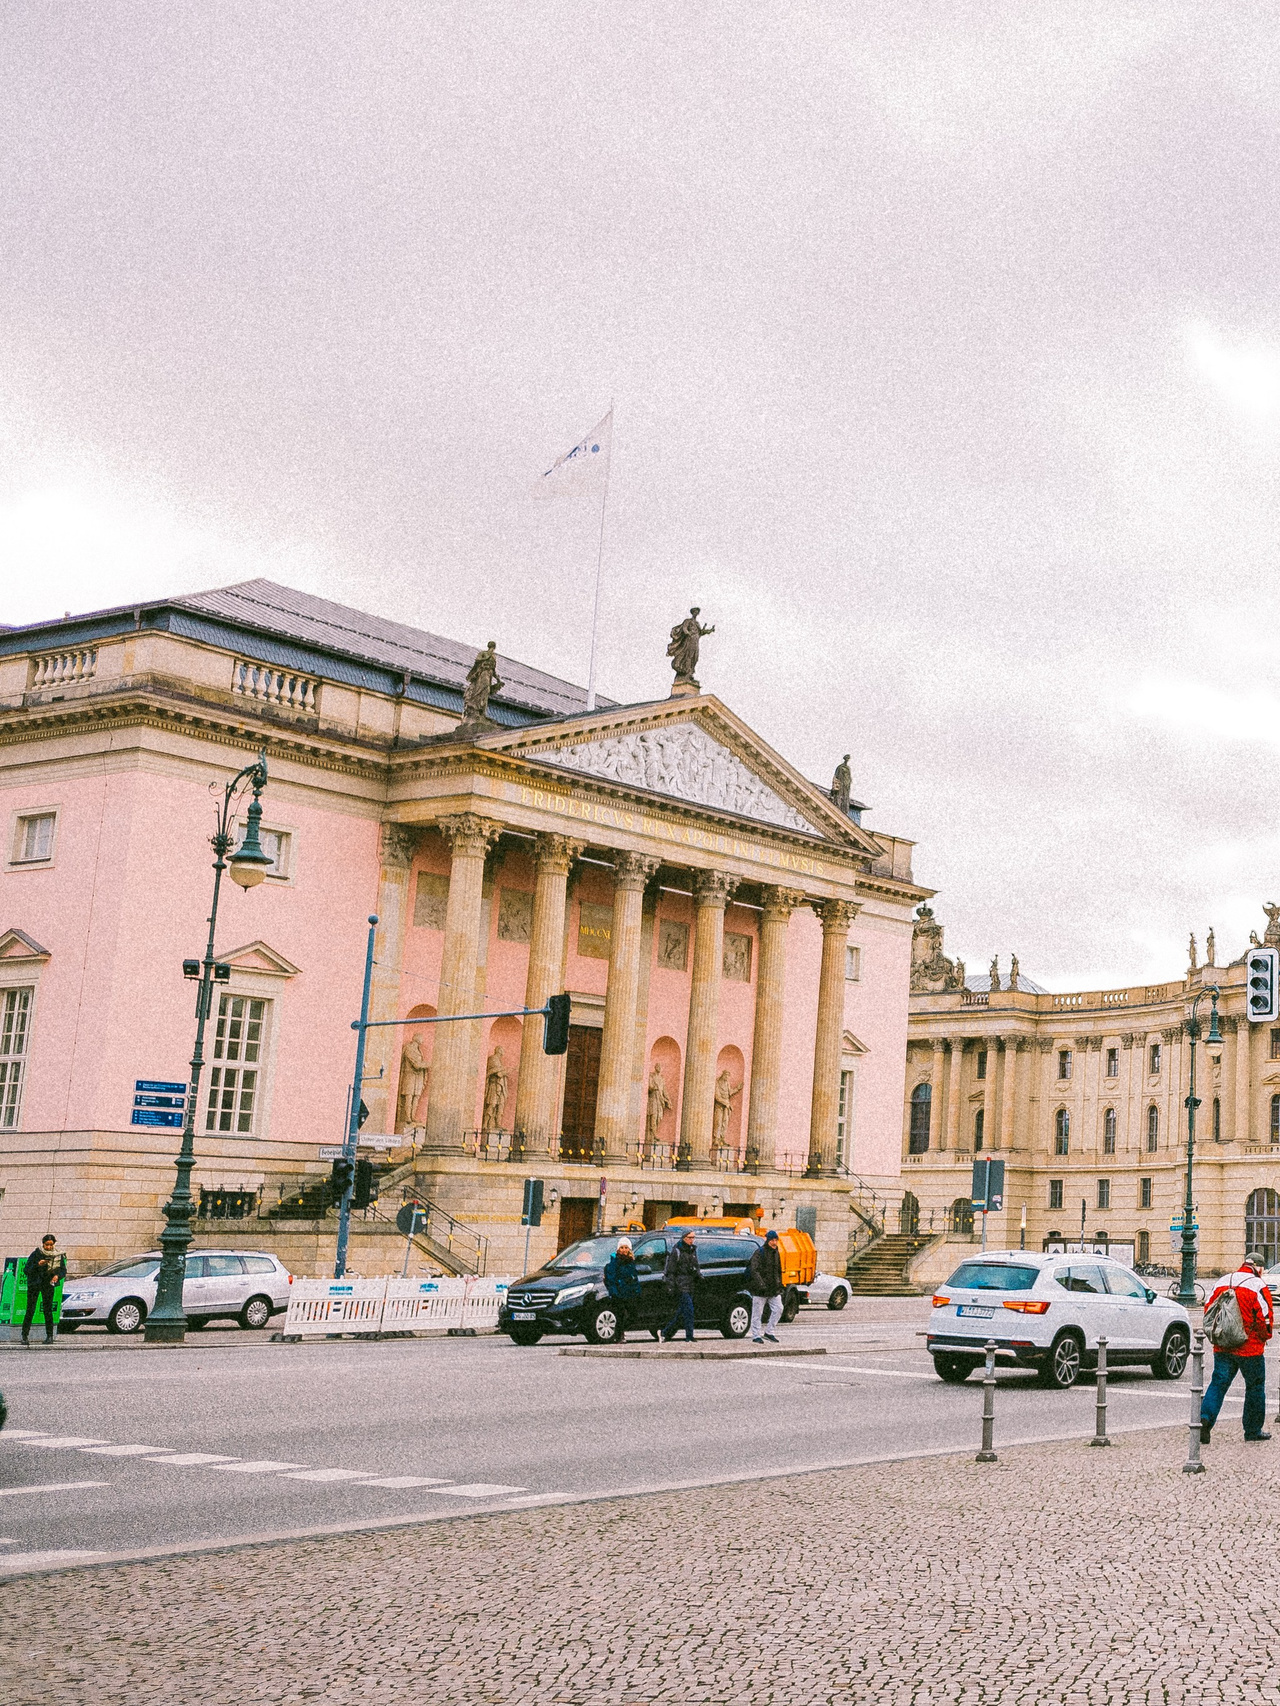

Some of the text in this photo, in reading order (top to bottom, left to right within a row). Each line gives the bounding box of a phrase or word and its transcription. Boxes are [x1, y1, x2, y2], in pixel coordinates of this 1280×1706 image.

[520, 787, 633, 829] FRIDERICVS
[641, 816, 677, 840] REX
[680, 828, 756, 858] APOLLINI
[779, 852, 825, 876] MVSIS
